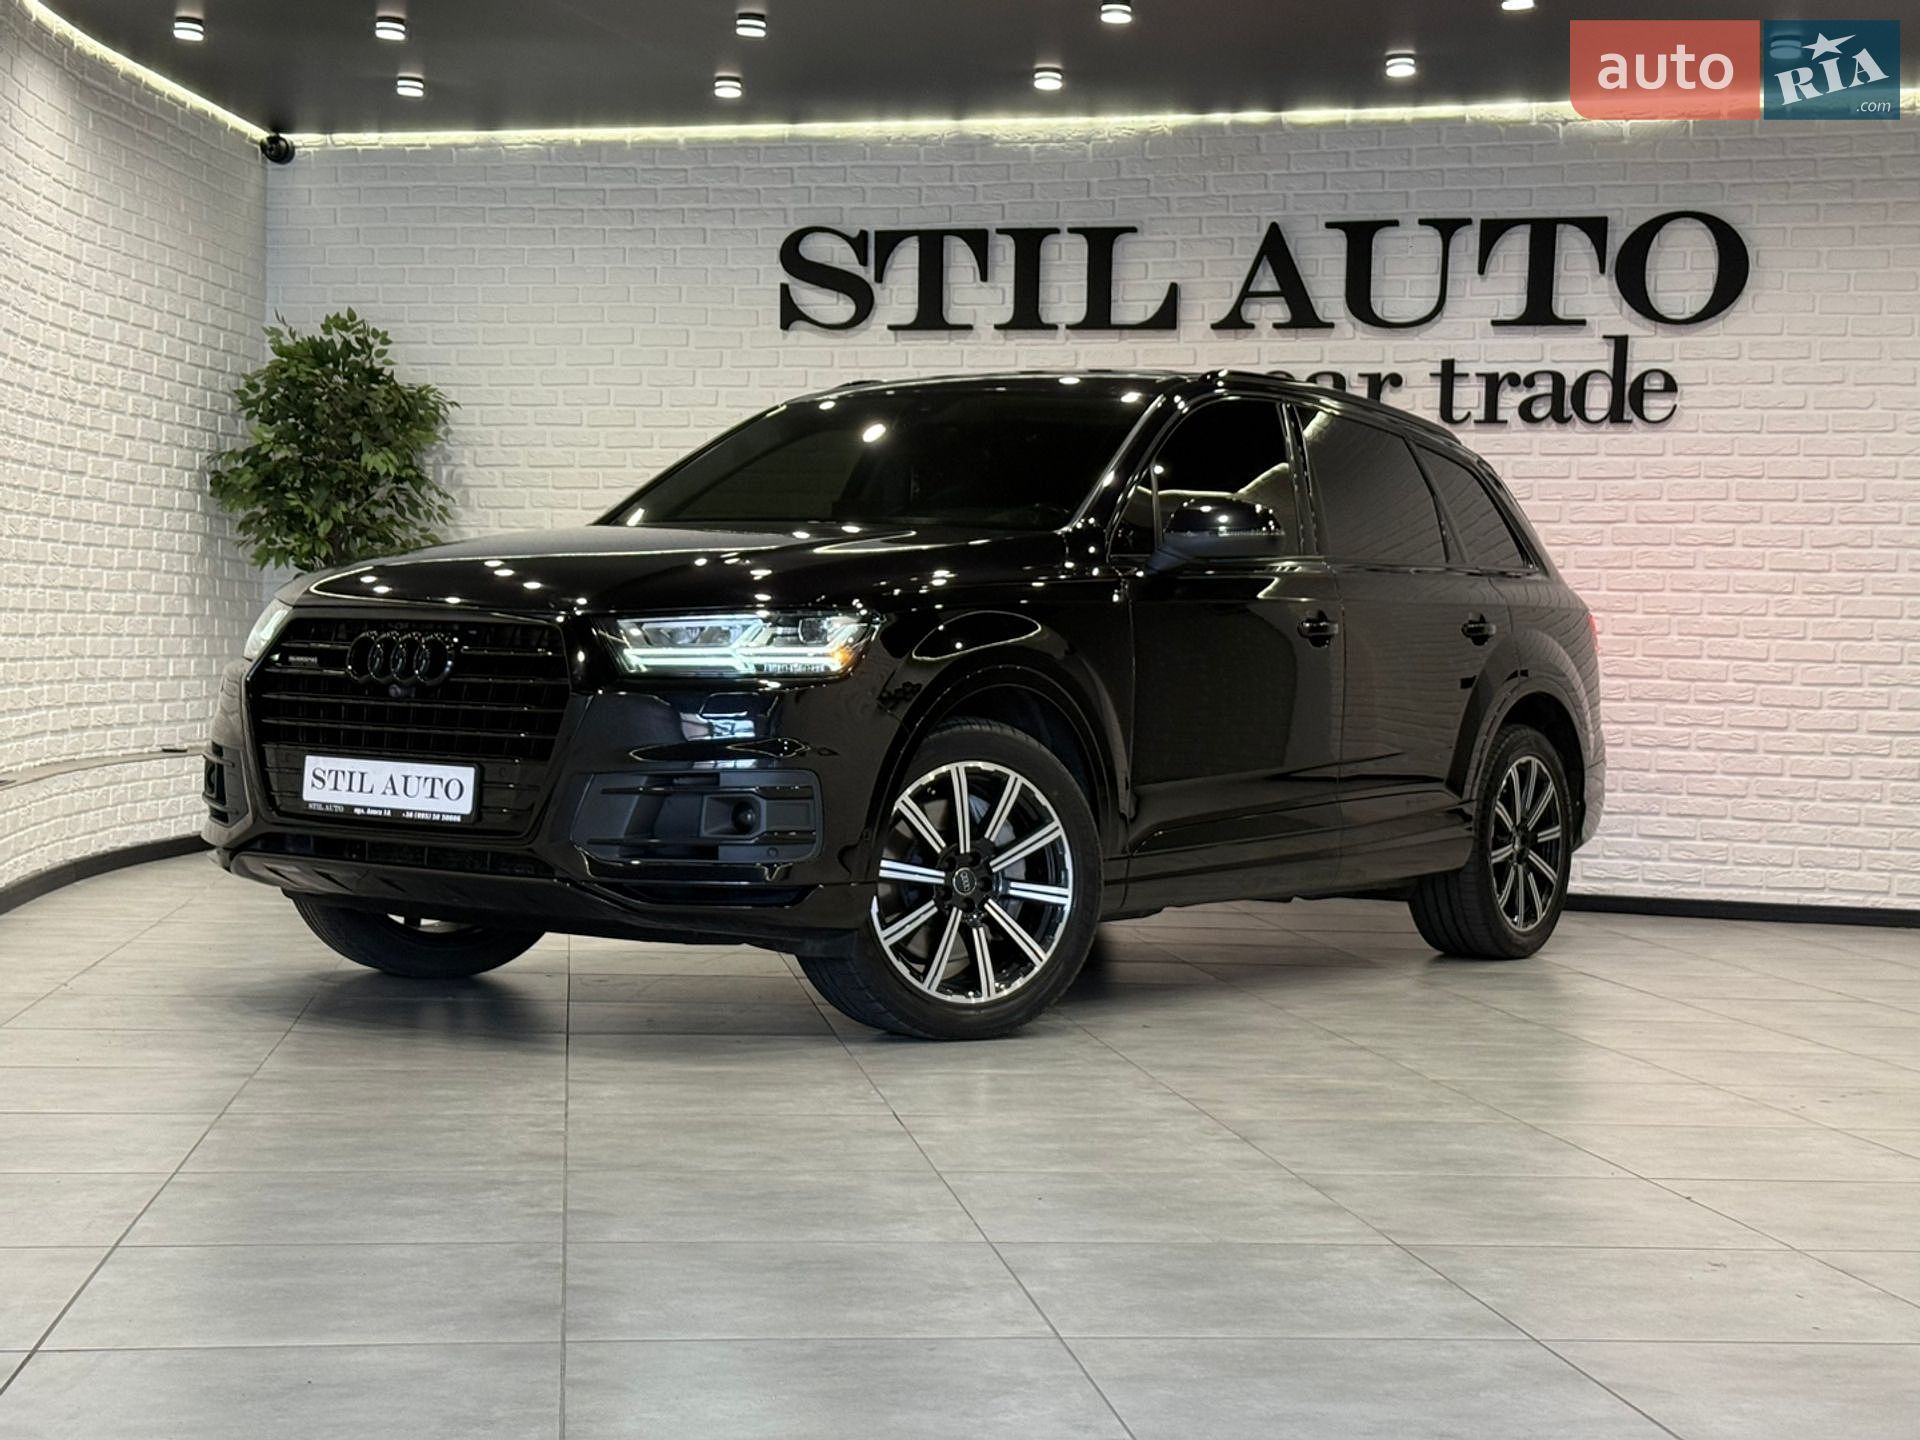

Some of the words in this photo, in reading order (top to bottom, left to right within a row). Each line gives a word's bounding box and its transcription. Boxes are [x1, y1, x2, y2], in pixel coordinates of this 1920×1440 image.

[779, 225, 1178, 332] STIL
[1210, 210, 1750, 330] AUTO
[1429, 335, 1678, 425] trade
[311, 767, 375, 795] STIL
[382, 773, 465, 802] AUTO
